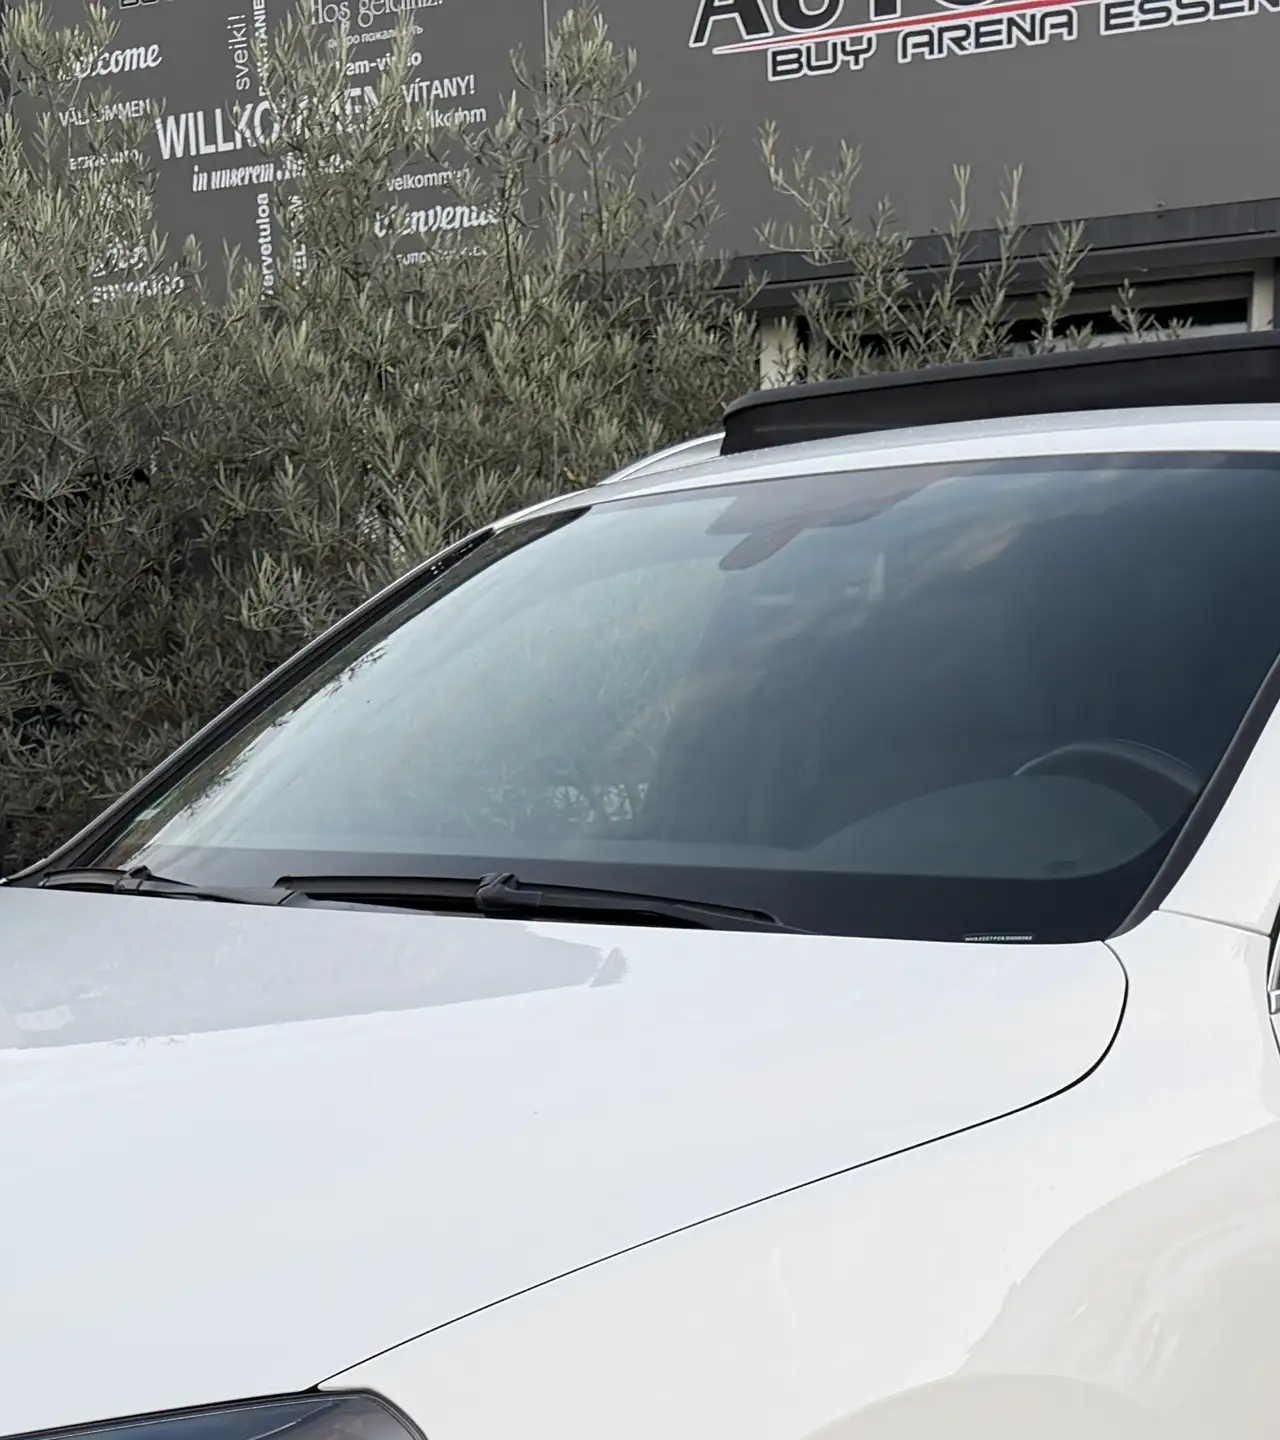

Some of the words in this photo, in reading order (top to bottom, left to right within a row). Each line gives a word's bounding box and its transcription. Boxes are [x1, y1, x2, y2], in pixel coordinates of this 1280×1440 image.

[226, 14, 251, 91] sveiki!
[768, 35, 876, 81] BUY
[897, 7, 1077, 63] ARENA
[192, 165, 208, 192] in
[210, 162, 275, 190] unserem
